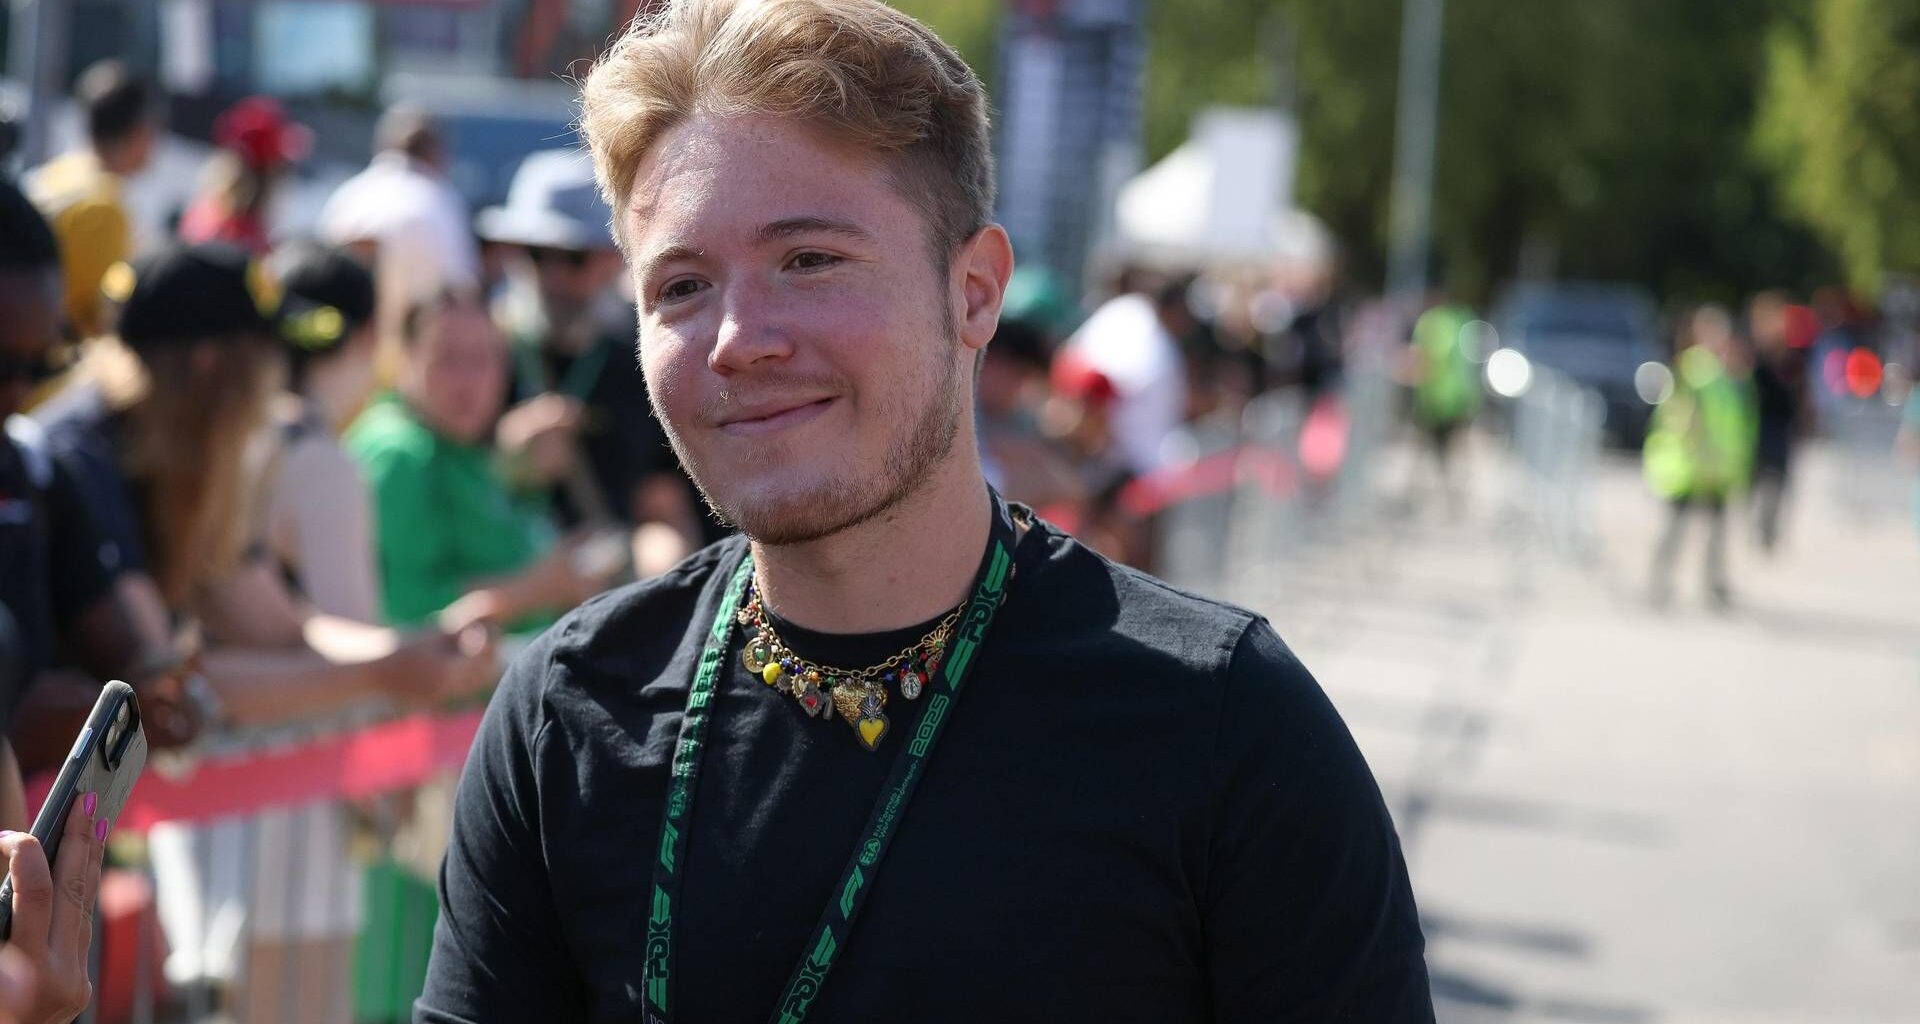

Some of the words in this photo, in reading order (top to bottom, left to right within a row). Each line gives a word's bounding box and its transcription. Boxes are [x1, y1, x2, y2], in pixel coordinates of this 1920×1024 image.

[689, 648, 720, 709] 2025
[908, 692, 949, 757] 2025
[860, 838, 880, 867] FIA
